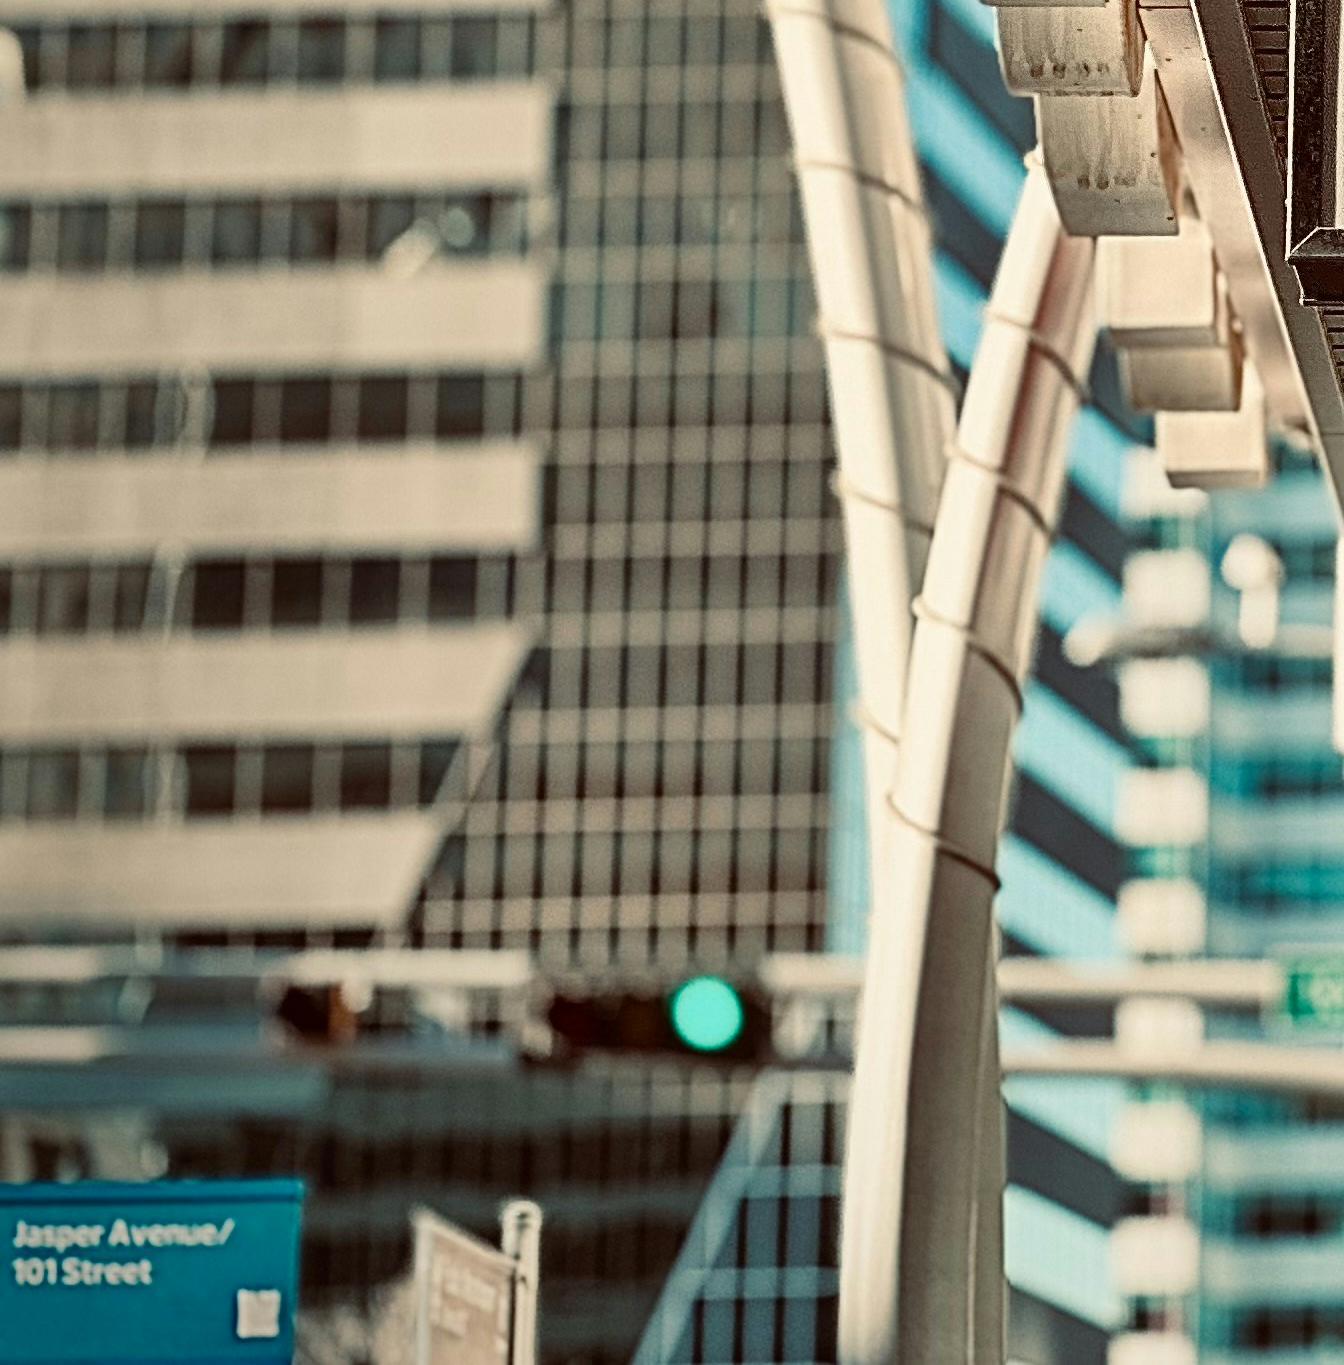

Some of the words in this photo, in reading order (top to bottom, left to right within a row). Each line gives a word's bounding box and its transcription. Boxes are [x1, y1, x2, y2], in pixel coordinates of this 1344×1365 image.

[13, 1219, 104, 1253] Jasper
[108, 1218, 235, 1246] Avenue/
[12, 1257, 58, 1285] 101
[61, 1257, 152, 1285] Street
